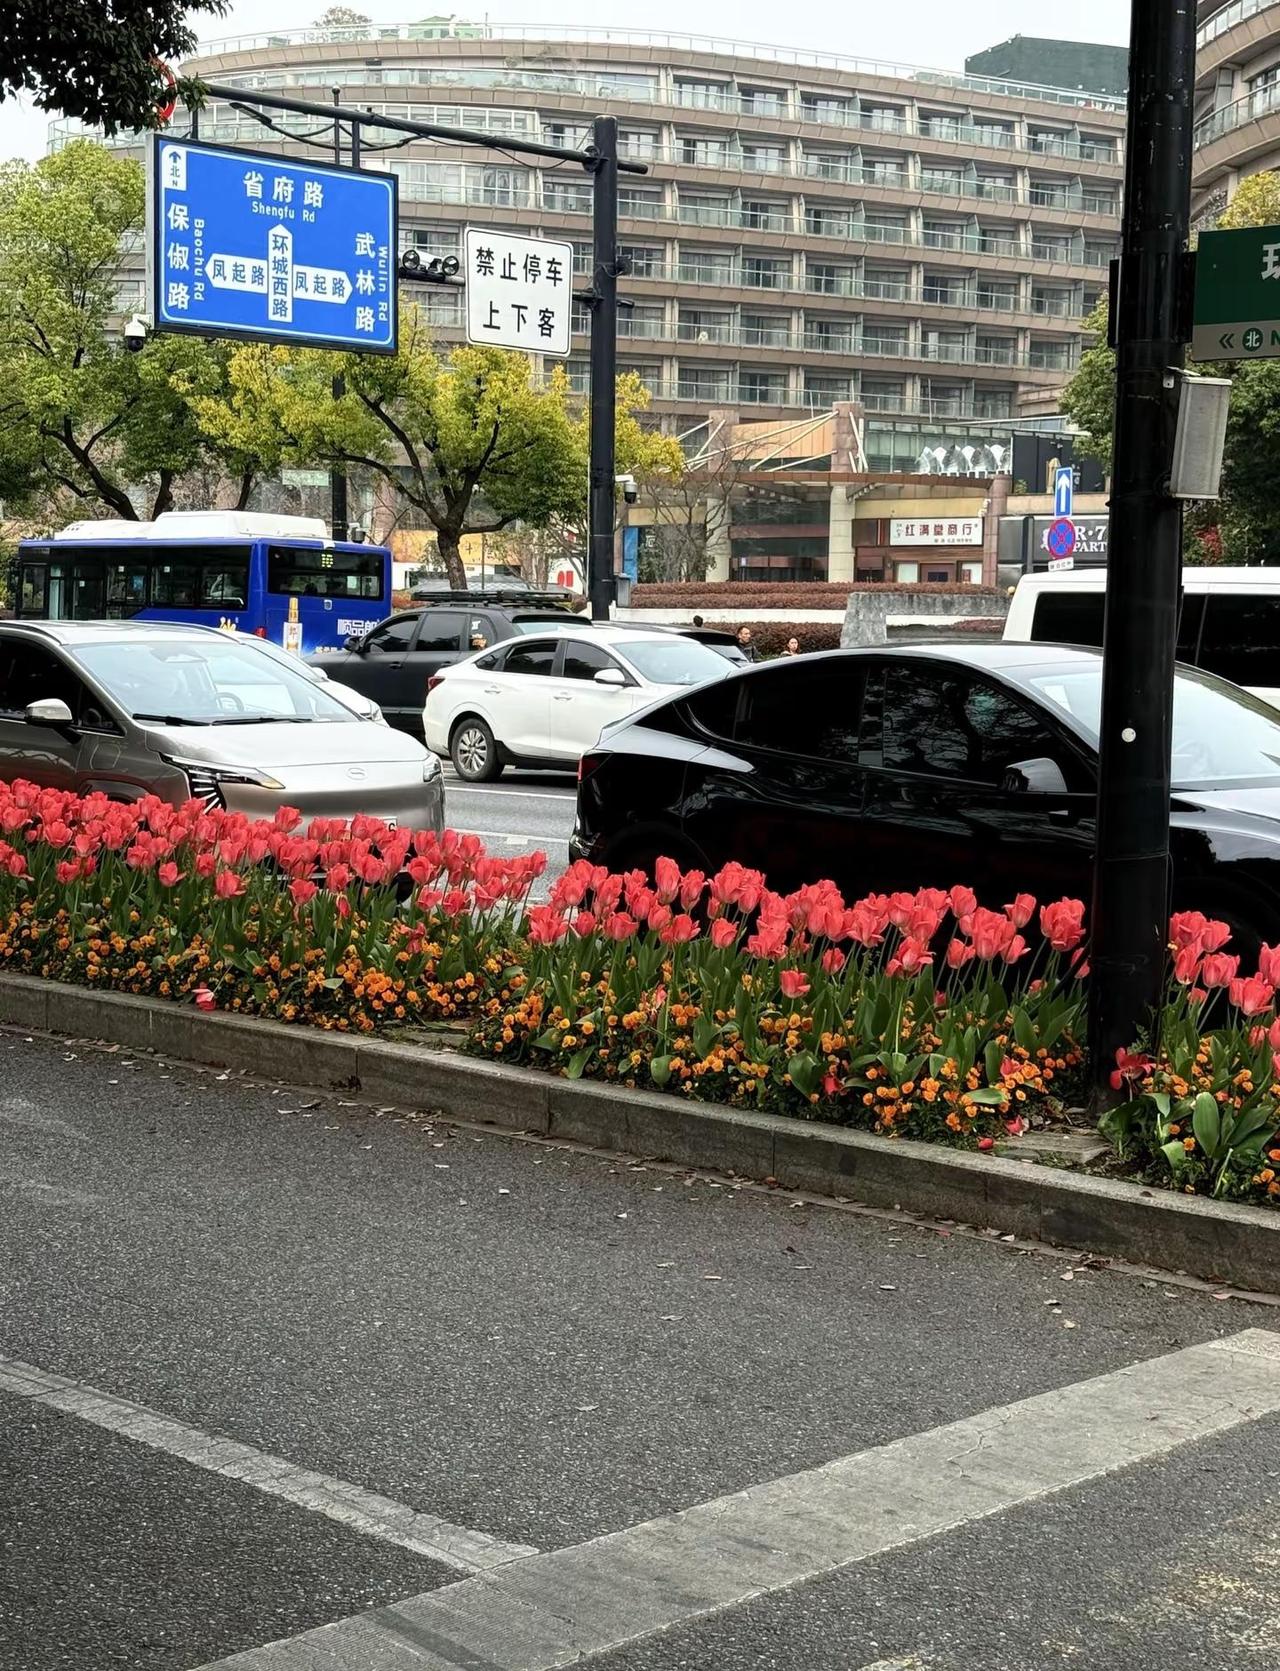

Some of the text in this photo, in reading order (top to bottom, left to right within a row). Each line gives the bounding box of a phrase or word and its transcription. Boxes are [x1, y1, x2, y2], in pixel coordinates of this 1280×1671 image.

[170, 165, 180, 177] 北
[243, 170, 324, 209] 省府路
[252, 201, 315, 223] Shengfu Rd
[167, 202, 190, 310] 保俶路
[194, 218, 205, 301] Baochu Rd
[212, 258, 265, 286] 凤起路
[272, 233, 289, 317] 环城西路
[476, 246, 563, 287] 禁止停车
[295, 271, 346, 298] 凤起路
[355, 232, 376, 333] 武林路
[378, 246, 388, 322] Wulin Rd
[483, 300, 555, 338] 上下客
[1245, 330, 1260, 347] 北
